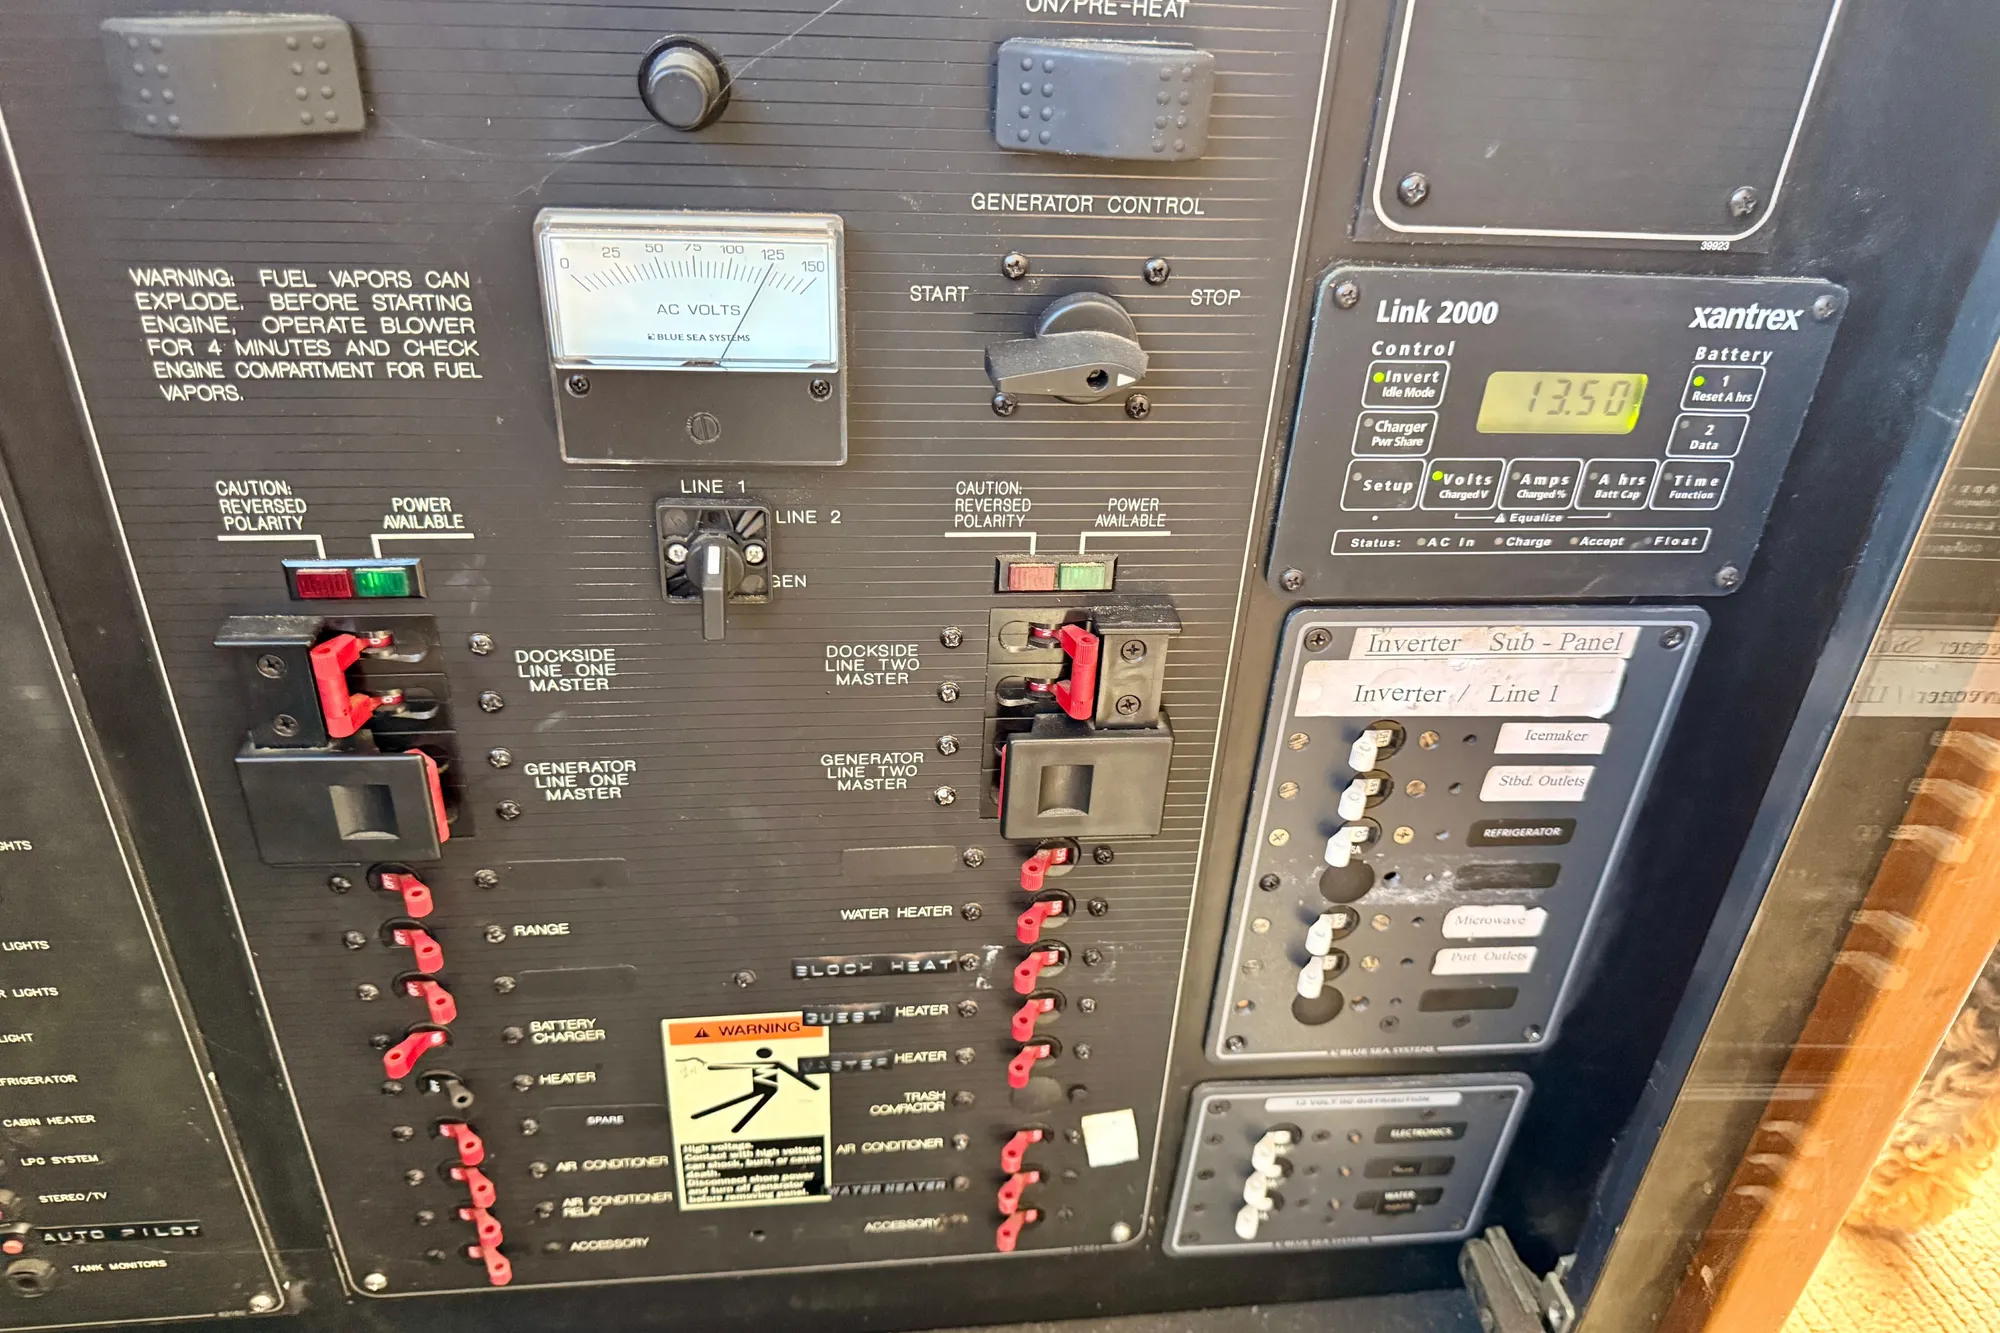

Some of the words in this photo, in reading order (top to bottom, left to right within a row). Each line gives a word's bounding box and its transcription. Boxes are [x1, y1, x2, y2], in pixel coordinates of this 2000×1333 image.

[1026, 0, 1189, 18] ON/PRE-HEAT
[971, 193, 1093, 213] GENERATOR
[1107, 196, 1205, 215] CONTROL
[602, 247, 621, 258] 25
[645, 243, 664, 253] 50
[720, 244, 744, 255] 100
[1700, 241, 1730, 251] 39923
[761, 249, 785, 261] 125
[801, 261, 825, 273] 150
[129, 268, 235, 288] WARNING:
[259, 269, 316, 288] FUEL
[329, 270, 412, 288] VAPORS
[425, 271, 470, 288] CAN
[910, 285, 970, 302] START
[1190, 289, 1241, 306] STOP
[135, 292, 244, 311] EXPLODE.
[270, 293, 358, 311] BEFORE
[372, 294, 473, 312] STARTING
[657, 304, 680, 316] AC
[688, 304, 741, 316] VOLTS
[1376, 299, 1432, 323] Link
[1436, 300, 1499, 324] 2000
[1688, 302, 1804, 331] xantrex
[141, 316, 236, 336] ENGINE,
[262, 317, 367, 334] OPERATE
[380, 317, 475, 334] BLOWER
[658, 333, 684, 341] BLUE
[687, 333, 707, 342] SEA
[710, 334, 750, 342] SYSTEMS
[148, 339, 193, 356] FOR
[208, 339, 222, 356] 4
[235, 339, 331, 356] MINUTES
[345, 339, 390, 356] AND
[404, 339, 480, 356] CHECK
[1372, 340, 1455, 356] Control
[1695, 346, 1772, 364] Battery
[154, 361, 225, 379] ENGINE
[235, 361, 375, 379] COMPARTMENT
[387, 361, 425, 378] FOR
[434, 361, 483, 378] FUEL
[1385, 370, 1440, 384] Invert
[159, 384, 245, 401] VAPORS.
[1382, 386, 1402, 398] Idle
[1404, 386, 1436, 398] Mode
[1528, 380, 1632, 416] 13.50
[1692, 391, 1723, 402] Reset
[1375, 420, 1428, 435] Charger
[1371, 436, 1393, 447] Pwr
[1394, 436, 1424, 447] Share
[1689, 440, 1719, 451] Data
[1444, 473, 1493, 486] Volts
[1519, 474, 1571, 487] Amps
[1597, 474, 1610, 485] A
[1618, 473, 1647, 485] hrs
[1674, 474, 1720, 487] Time
[215, 480, 292, 496] CAUTION:
[681, 480, 724, 494] LINE
[738, 480, 746, 493] 1
[956, 481, 1022, 495] CAUTION:
[1363, 479, 1413, 494] Setup
[1439, 489, 1479, 500] Charged
[1516, 490, 1556, 499] Charged
[1594, 490, 1619, 499] Batt
[1620, 490, 1641, 501] Cap
[1669, 490, 1714, 500] Function
[220, 499, 307, 514] REVERSED
[392, 497, 452, 512] POWER
[955, 498, 1032, 512] REVERSED
[1108, 498, 1159, 511] POWER
[224, 515, 303, 531] POLARITY
[383, 514, 465, 529] AVAILABLE
[776, 510, 817, 524] LINE
[831, 510, 842, 523] 2
[954, 514, 1025, 528] POLARITY
[1095, 514, 1167, 527] AVAILABLE
[1509, 512, 1563, 523] Equalize
[1350, 538, 1401, 548] Status:
[1427, 537, 1450, 547] AC
[1458, 537, 1476, 547] In
[1506, 536, 1552, 547] Charge
[1579, 536, 1625, 548] Accept
[1654, 536, 1699, 546] Float
[772, 575, 807, 588] GEN
[1366, 633, 1462, 653] Inverter
[1490, 632, 1534, 651] Sub
[1560, 632, 1624, 651] Panel
[515, 649, 616, 664] DOCKSIDE
[826, 644, 919, 658] DOCKSIDE
[517, 664, 562, 678] LINE
[575, 663, 616, 677] ONE
[825, 659, 865, 672] LINE
[878, 658, 920, 671] TWO
[529, 678, 610, 692] MASTER
[836, 672, 909, 685] MASTER
[1354, 685, 1447, 703] Inverter
[1488, 685, 1540, 703] Line
[1524, 729, 1589, 742] Icemaker
[820, 752, 924, 766] GENERATOR
[524, 760, 637, 776] GENERATOR
[827, 766, 865, 779] LINE
[878, 765, 917, 777] TWO
[535, 775, 577, 789] LINE
[590, 774, 630, 787] ONE
[837, 778, 907, 791] MASTER
[1499, 775, 1533, 786] Stbd.
[1539, 775, 1585, 786] Outlets
[545, 787, 622, 801] MASTER
[1484, 827, 1563, 838] REFRIGERATOR
[840, 907, 889, 921] WATER
[897, 905, 953, 918] HEATER
[1455, 915, 1526, 926] Microwave
[512, 922, 570, 937] RANGE
[2, 940, 50, 951] LIGHTS
[1451, 952, 1477, 961] Port
[1484, 951, 1528, 961] Outlets
[891, 959, 952, 973] HEAT
[12, 987, 59, 998] LIGHTS
[895, 1004, 949, 1017] HEATER
[529, 1018, 597, 1033] BATTERY
[718, 1021, 801, 1036] WARNING
[531, 1029, 606, 1045] CHARGER
[894, 1050, 947, 1064] HEATER
[538, 1071, 597, 1086] HEATER
[904, 1090, 946, 1102] TRASH
[869, 1101, 945, 1117] COMPACTOR
[3, 1118, 41, 1128] CABIN
[47, 1114, 97, 1126] HEATER
[586, 1115, 624, 1126] SPARE
[1390, 1127, 1453, 1139] ELECTRONICS
[836, 1143, 856, 1155] AIR
[861, 1137, 944, 1154] CONDITIONER
[21, 1156, 45, 1166] LPG
[51, 1154, 99, 1165] SYSTEM
[555, 1161, 578, 1173] AIR
[582, 1155, 669, 1171] CONDITIONER
[884, 1180, 947, 1193] HEATER
[39, 1192, 108, 1204] STEREO/TV
[561, 1196, 584, 1208] AIR
[587, 1191, 673, 1206] CONDITIONER
[562, 1206, 603, 1218] RELAY
[864, 1217, 940, 1234] ACCESSORY
[43, 1229, 105, 1243] AUTO
[120, 1225, 200, 1237] PILOT
[569, 1236, 649, 1252] ACCESSORY
[72, 1263, 104, 1273] TANK
[109, 1259, 168, 1271] MONITORS
